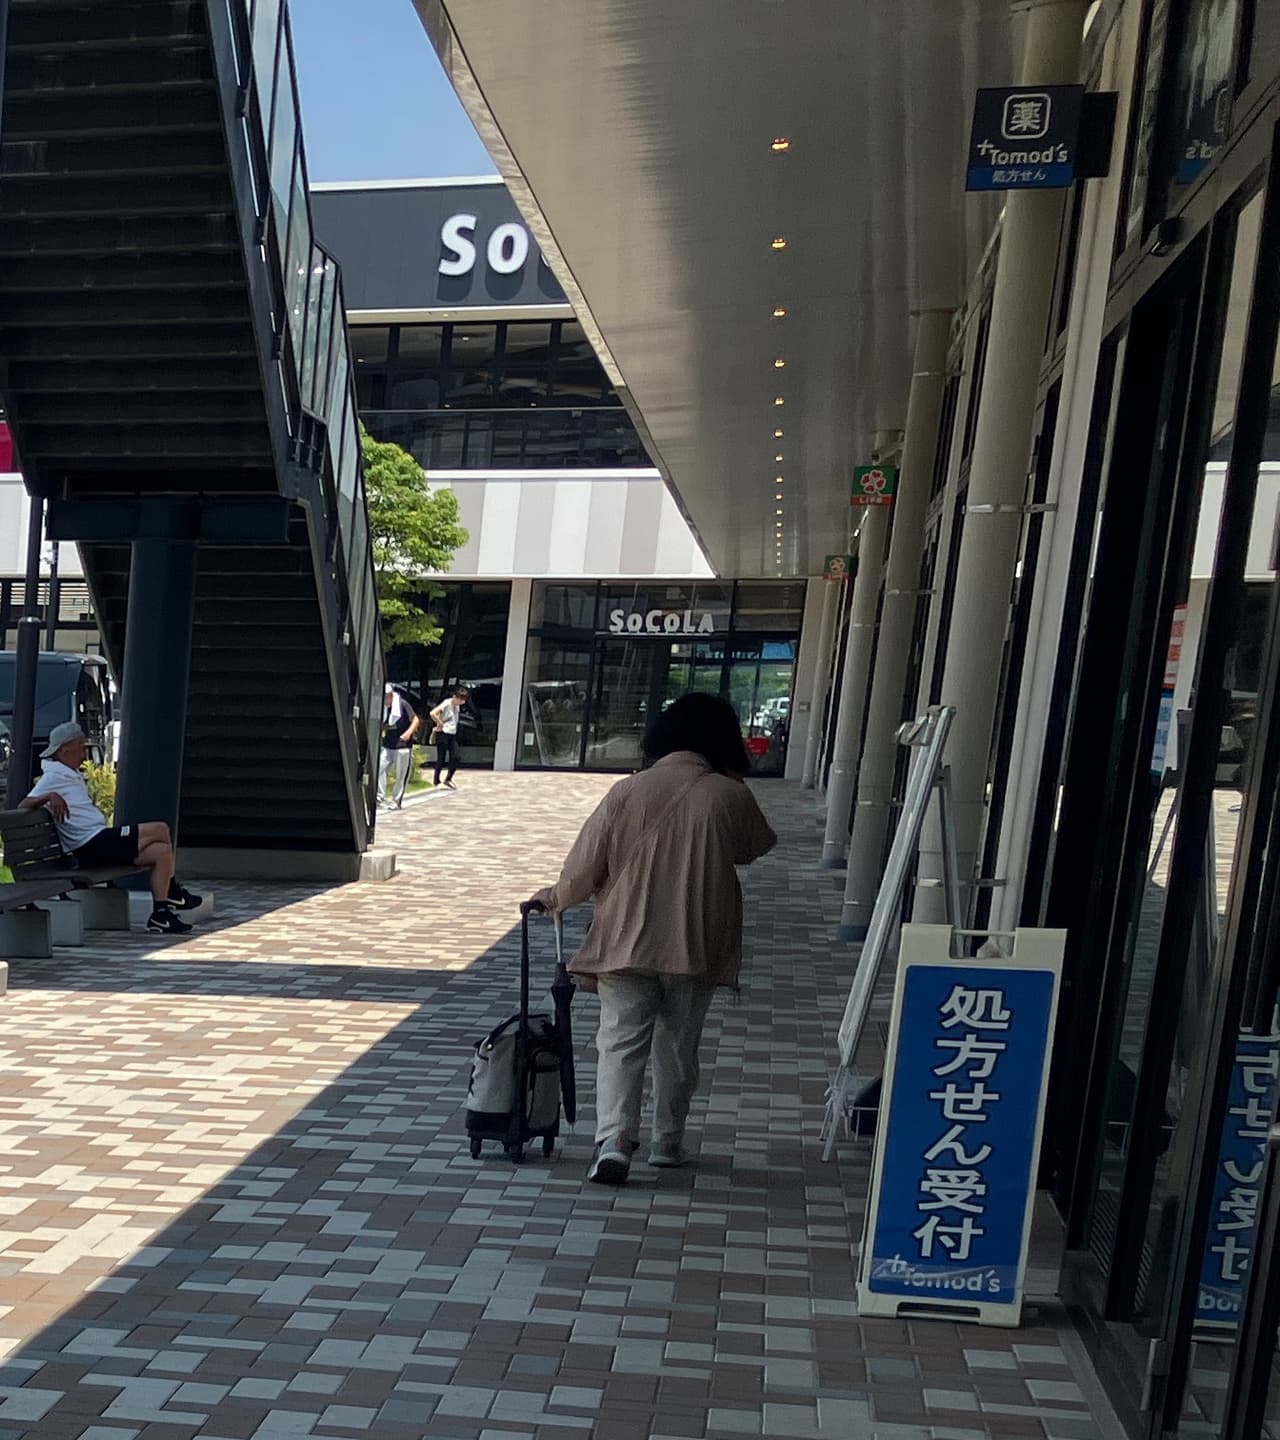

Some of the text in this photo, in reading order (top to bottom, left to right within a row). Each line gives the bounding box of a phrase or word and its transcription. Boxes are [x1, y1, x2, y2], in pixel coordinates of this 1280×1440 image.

[1008, 100, 1043, 132] 薬
[991, 169, 1046, 183] 処方せん
[438, 213, 550, 276] So
[912, 985, 1011, 1260] 処方せん受付
